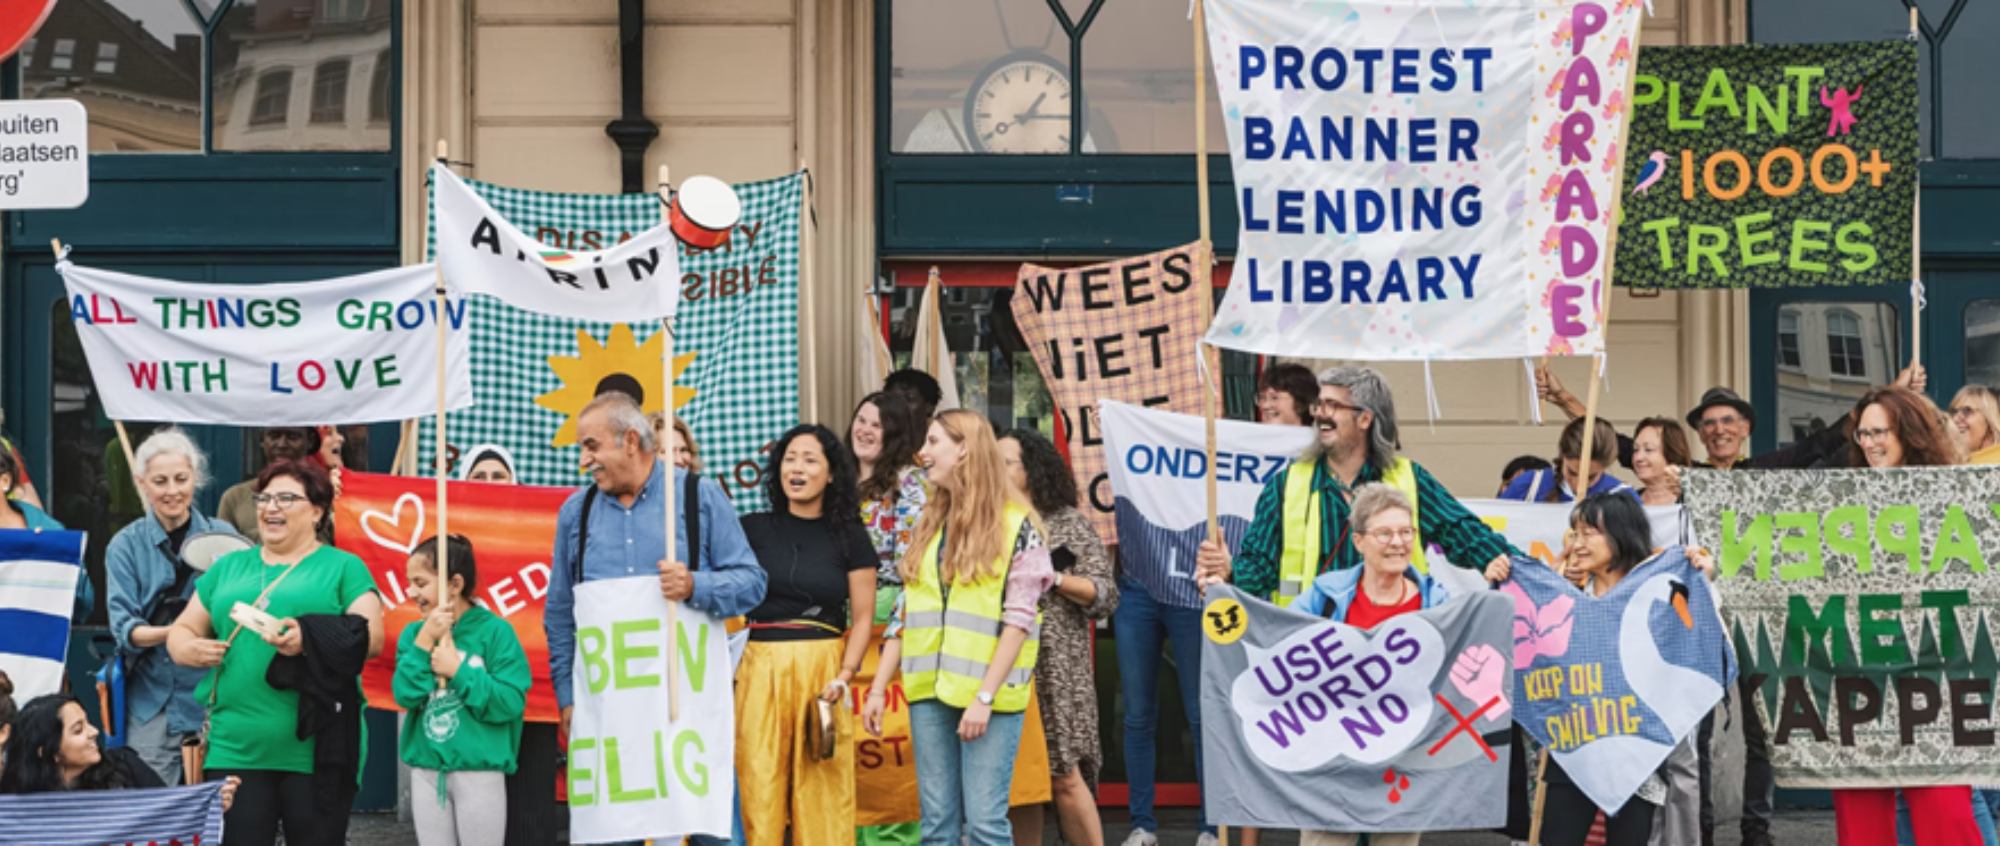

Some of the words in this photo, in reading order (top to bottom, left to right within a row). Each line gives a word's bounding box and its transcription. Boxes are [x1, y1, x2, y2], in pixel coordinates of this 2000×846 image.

[1239, 46, 1493, 93] PROTEST
[0, 113, 59, 134] uiten
[1630, 67, 1825, 134] PLANT
[0, 142, 79, 162] aatsen
[1244, 116, 1480, 163] BANNER
[1681, 143, 1892, 201] 1000+
[1243, 185, 1482, 234] LENDING
[1642, 211, 1878, 277] TREES
[1023, 253, 1192, 314] WEES
[1248, 254, 1482, 304] LIBRARY
[71, 293, 138, 325] ALL
[153, 297, 301, 330] THINGS
[337, 298, 466, 332] GROW
[128, 358, 228, 393] WITH
[270, 355, 401, 394] LOVE
[1126, 444, 1297, 484] ONDERZ
[1788, 589, 1970, 664] MET
[575, 618, 709, 695] BEN
[1254, 627, 1354, 696] USE
[1523, 666, 1564, 701] KEEP
[1569, 662, 1603, 695] ON
[1256, 627, 1421, 749] WORDS
[1340, 693, 1409, 750] NO
